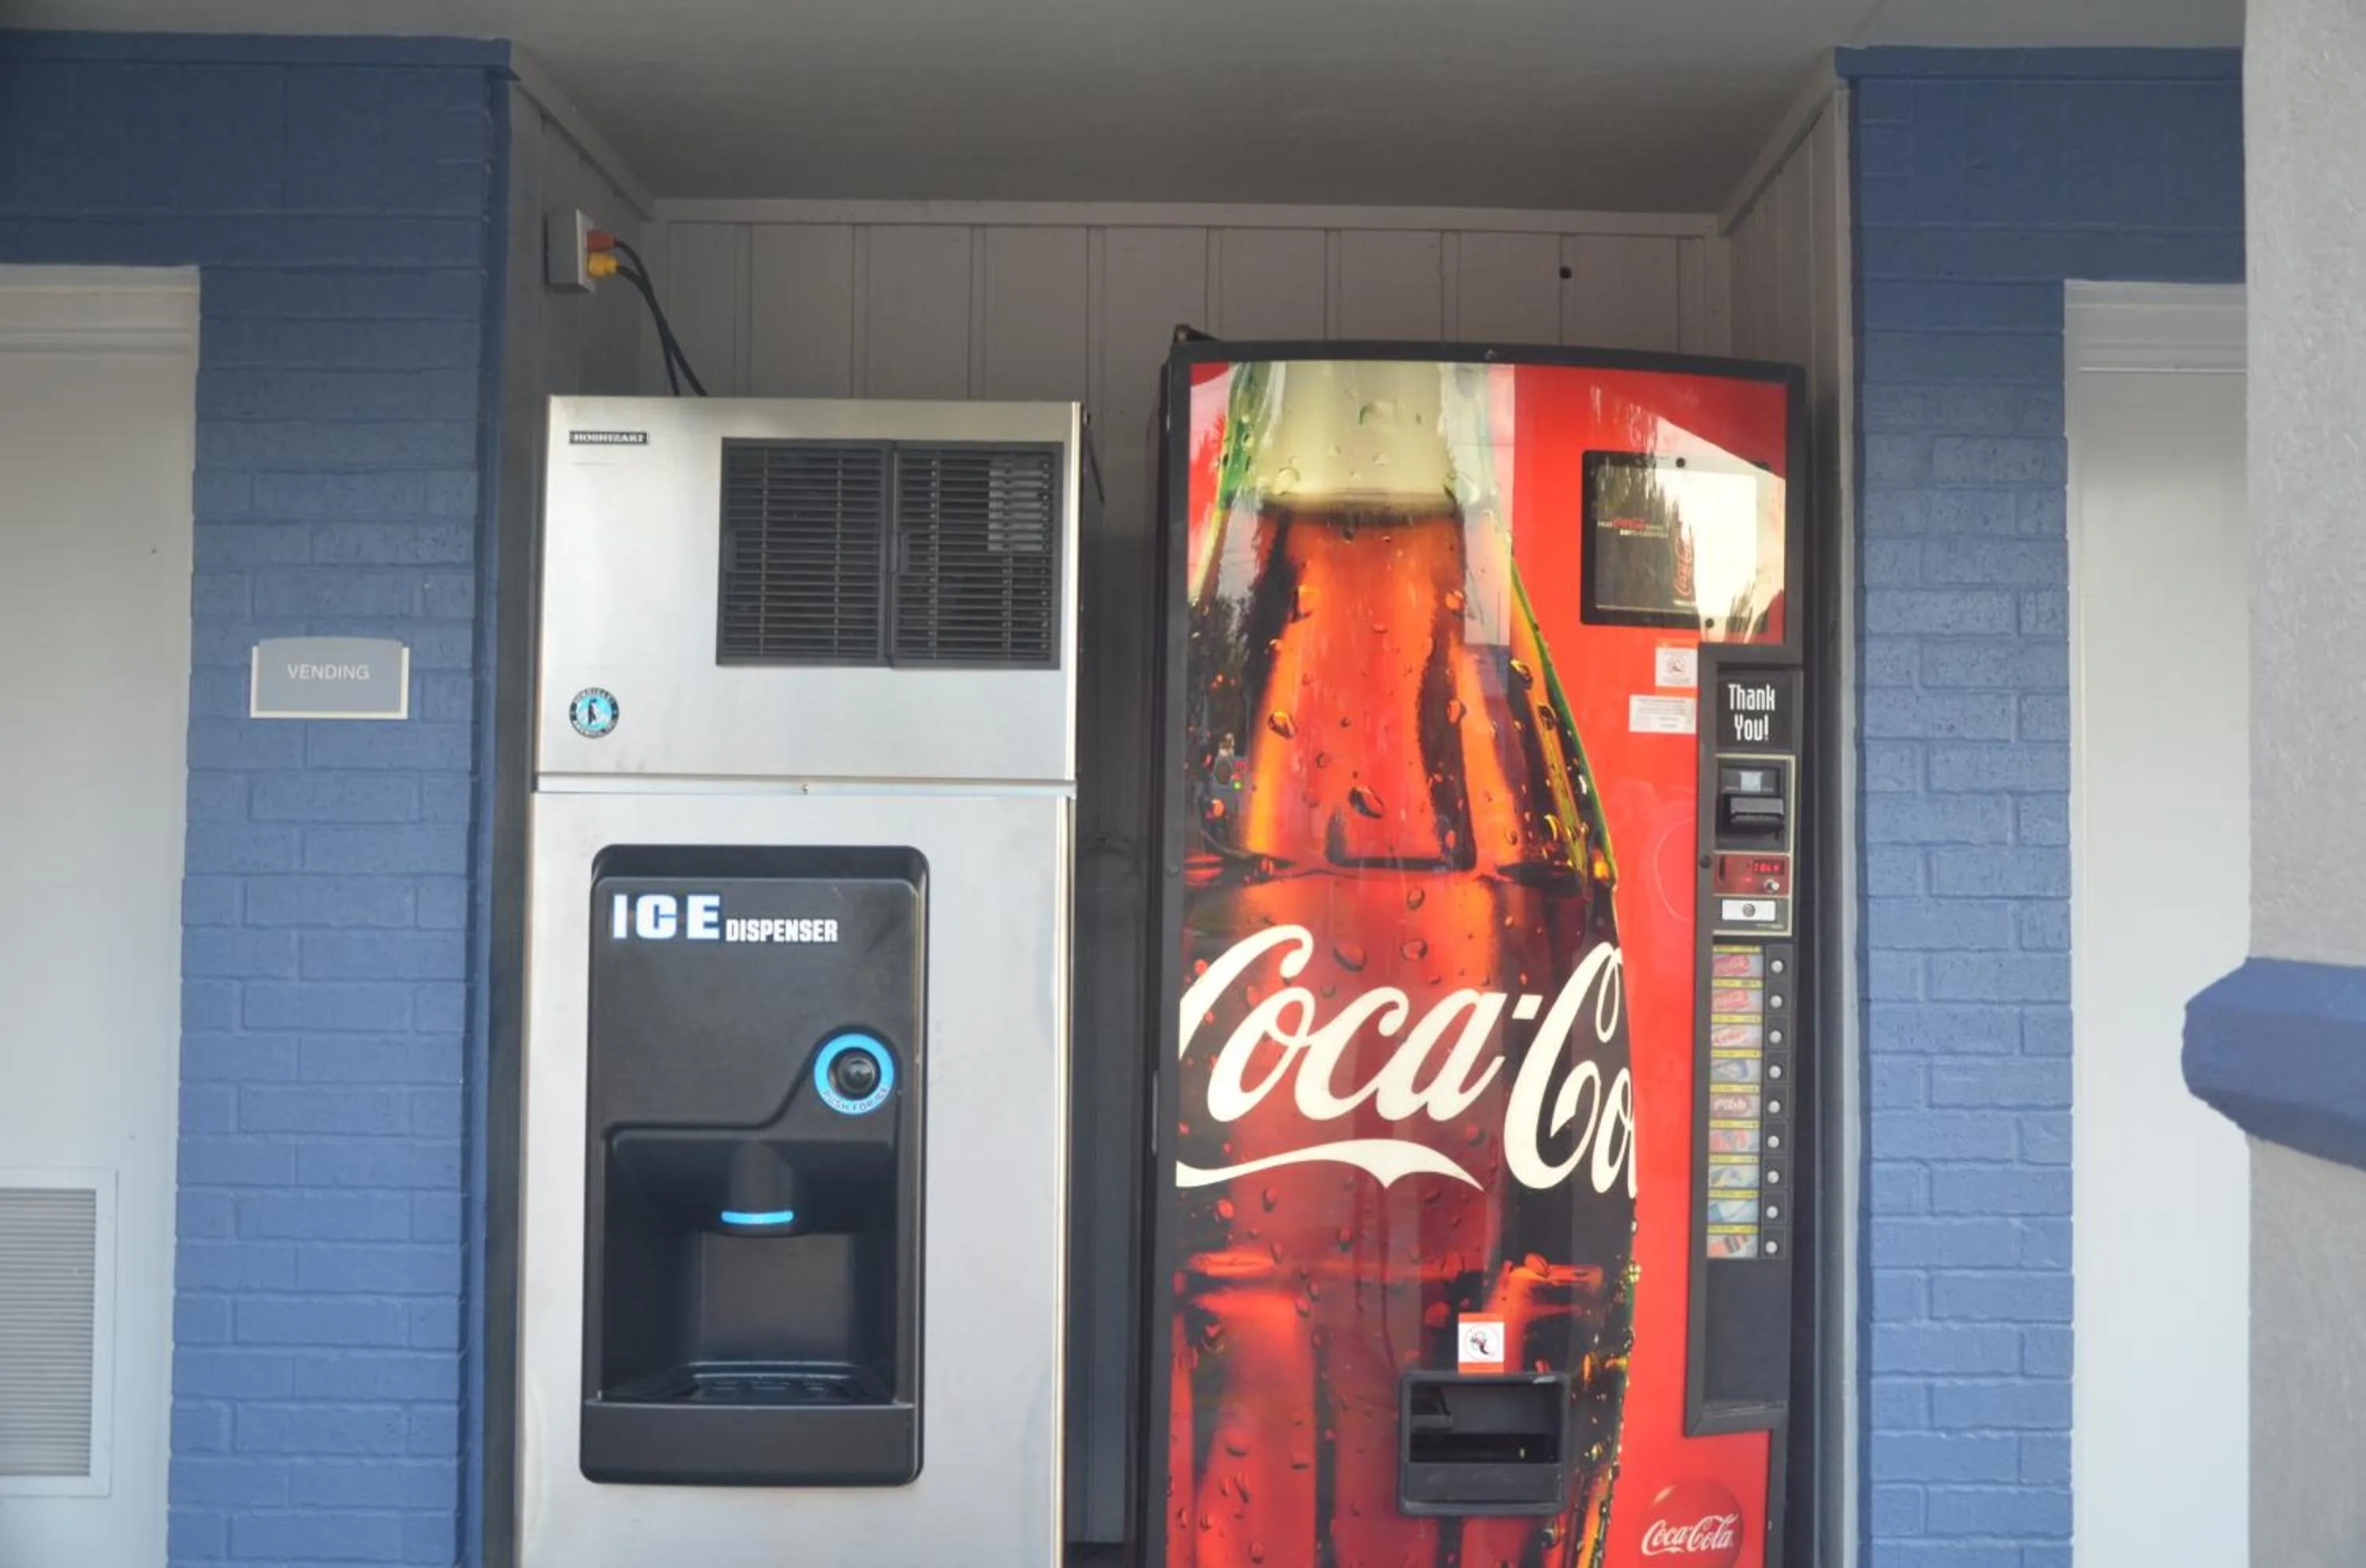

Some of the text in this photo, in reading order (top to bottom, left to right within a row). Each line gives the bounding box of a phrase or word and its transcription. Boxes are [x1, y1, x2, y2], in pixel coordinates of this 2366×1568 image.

[287, 663, 370, 681] VENDING
[1728, 683, 1775, 711] Thank
[1734, 714, 1769, 741] You!
[613, 894, 838, 943] ICE DISPENSER
[852, 1100, 874, 1111] FOR
